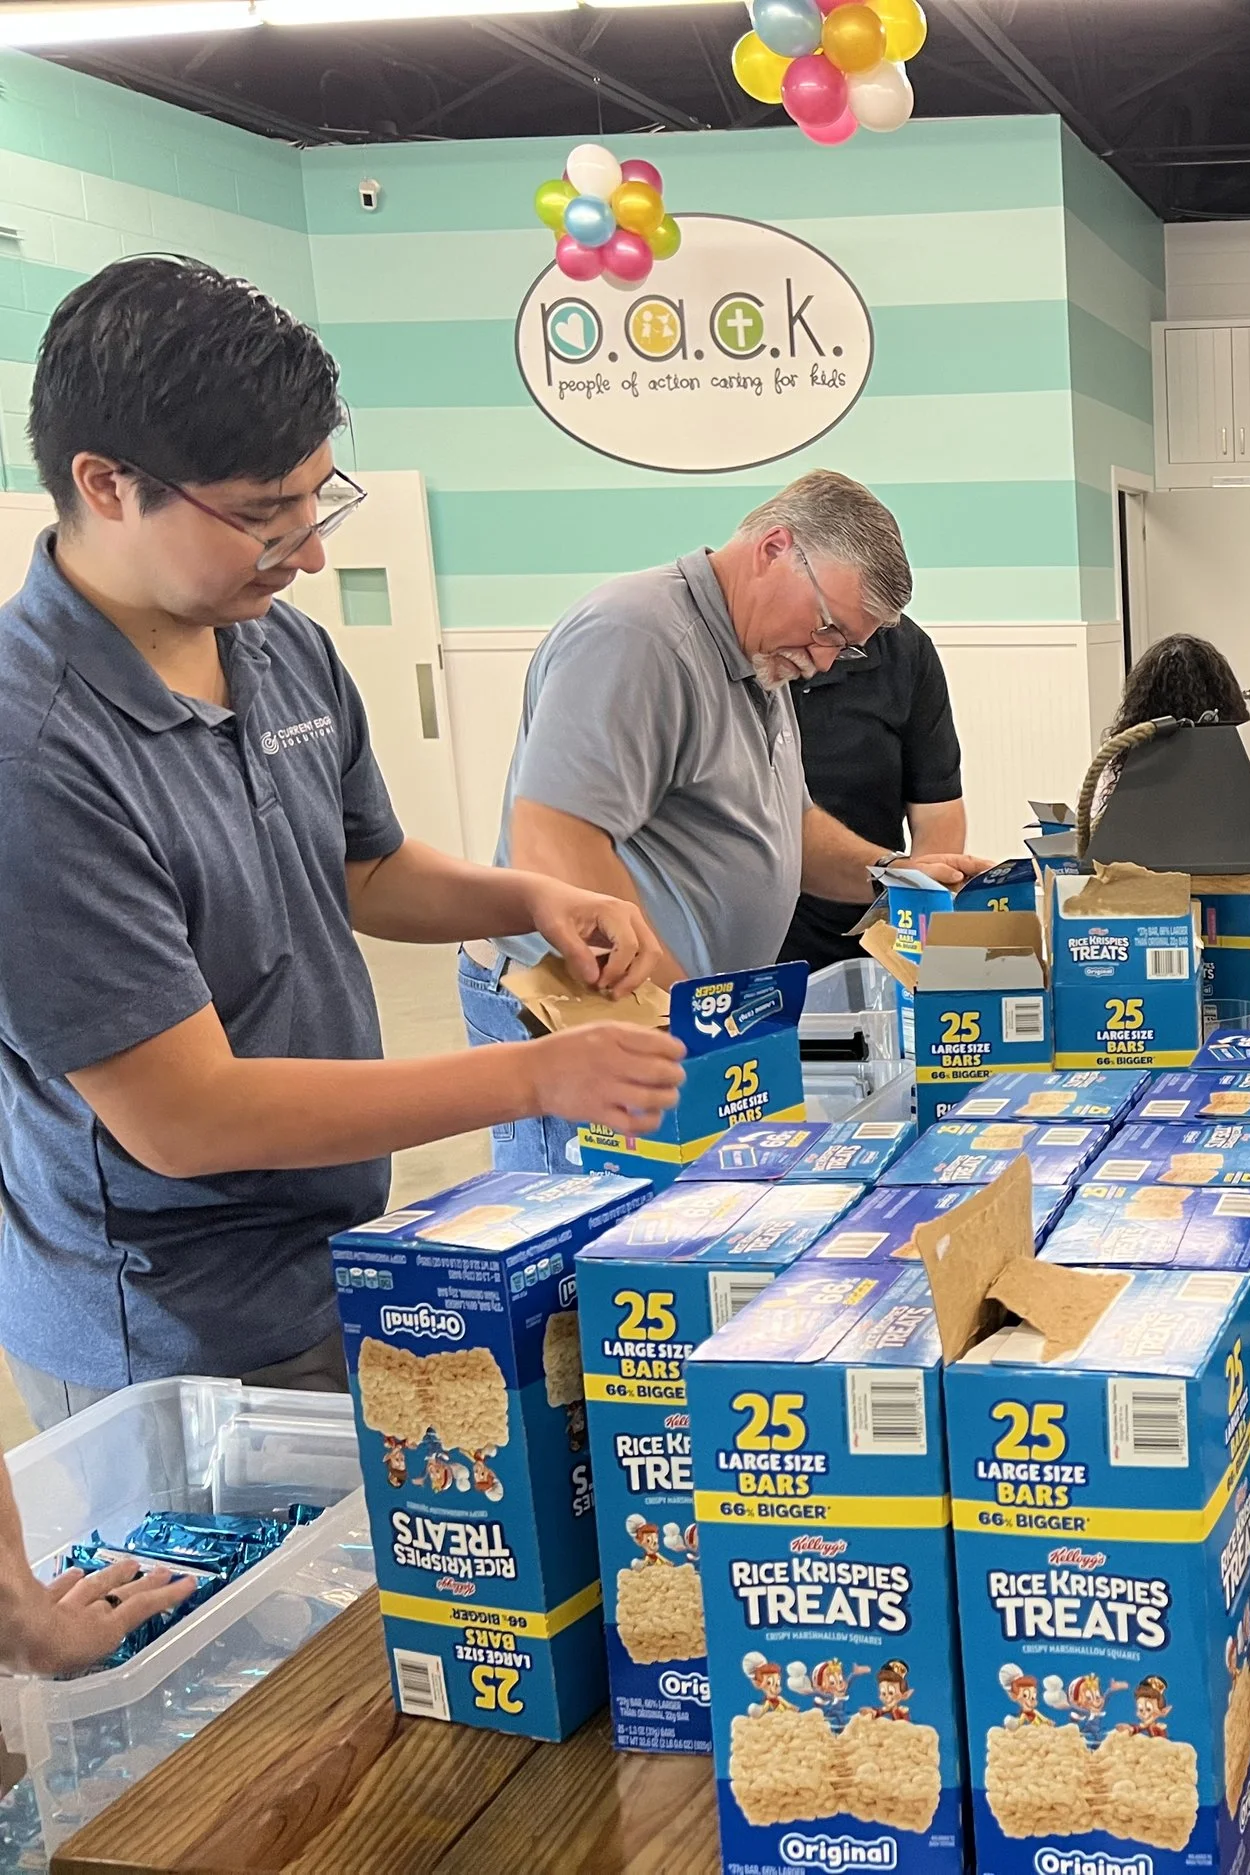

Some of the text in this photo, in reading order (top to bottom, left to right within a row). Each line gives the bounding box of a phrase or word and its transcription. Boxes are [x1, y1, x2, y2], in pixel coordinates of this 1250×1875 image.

[559, 363, 845, 399] people of action caring for kids
[278, 721, 313, 739] CURRENT
[897, 910, 912, 928] 25
[1069, 936, 1129, 948] RICE KRISPIES
[1070, 946, 1128, 962] TREATS
[695, 982, 734, 997] BIGGER
[1106, 999, 1144, 1030] 25
[940, 1012, 980, 1043] 25
[1097, 1030, 1154, 1040] LARGE SIZE
[931, 1043, 990, 1055] LARGE SIZE
[1107, 1041, 1145, 1052] BARS
[942, 1055, 981, 1067] BARS
[1116, 1057, 1153, 1065] BIGGER
[725, 1059, 759, 1103] 25
[952, 1070, 990, 1078] BIGGER
[718, 1091, 769, 1118] LARGE SIZE
[729, 1105, 763, 1128] BARS
[385, 1307, 460, 1335] Original
[614, 1291, 676, 1341] 25
[878, 1307, 933, 1349] TREATS
[604, 1341, 693, 1360] LARGE SIZE
[621, 1359, 680, 1379] BARS
[1225, 1338, 1243, 1416] 25
[637, 1385, 685, 1399] BIGGE
[732, 1392, 806, 1451] 25
[992, 1401, 1066, 1462] 25
[616, 1436, 665, 1457] RICE
[718, 1452, 826, 1472] LARGE SIZE
[977, 1461, 1086, 1484] LARGE SIZE
[622, 1457, 694, 1491] TRE
[738, 1472, 810, 1495] BARS
[997, 1483, 1069, 1507] BARS
[392, 1512, 510, 1558] TREATS
[791, 1535, 847, 1556] Kellogg's
[394, 1544, 516, 1579] RICE KRISPIES
[1049, 1547, 1106, 1569] Kellogg's
[436, 1577, 476, 1596] Kellogg's
[732, 1558, 909, 1592] RICE KRISPIES
[990, 1569, 1169, 1608] RICE KRISPIES
[451, 1608, 500, 1625] BIGGER
[738, 1585, 907, 1632] TREATS
[996, 1597, 1167, 1648] TREATS
[465, 1628, 515, 1651] BARS
[766, 1631, 882, 1645] CRISPY MARSHMALLOW SQUARES
[456, 1646, 531, 1669] LARGE SIZE
[1022, 1644, 1141, 1662] CRISPY MARSHMALLOW SQUARES
[472, 1664, 524, 1714] 25
[664, 1677, 711, 1699] Orig
[786, 1839, 890, 1866] Original
[1041, 1854, 1146, 1875] Original
